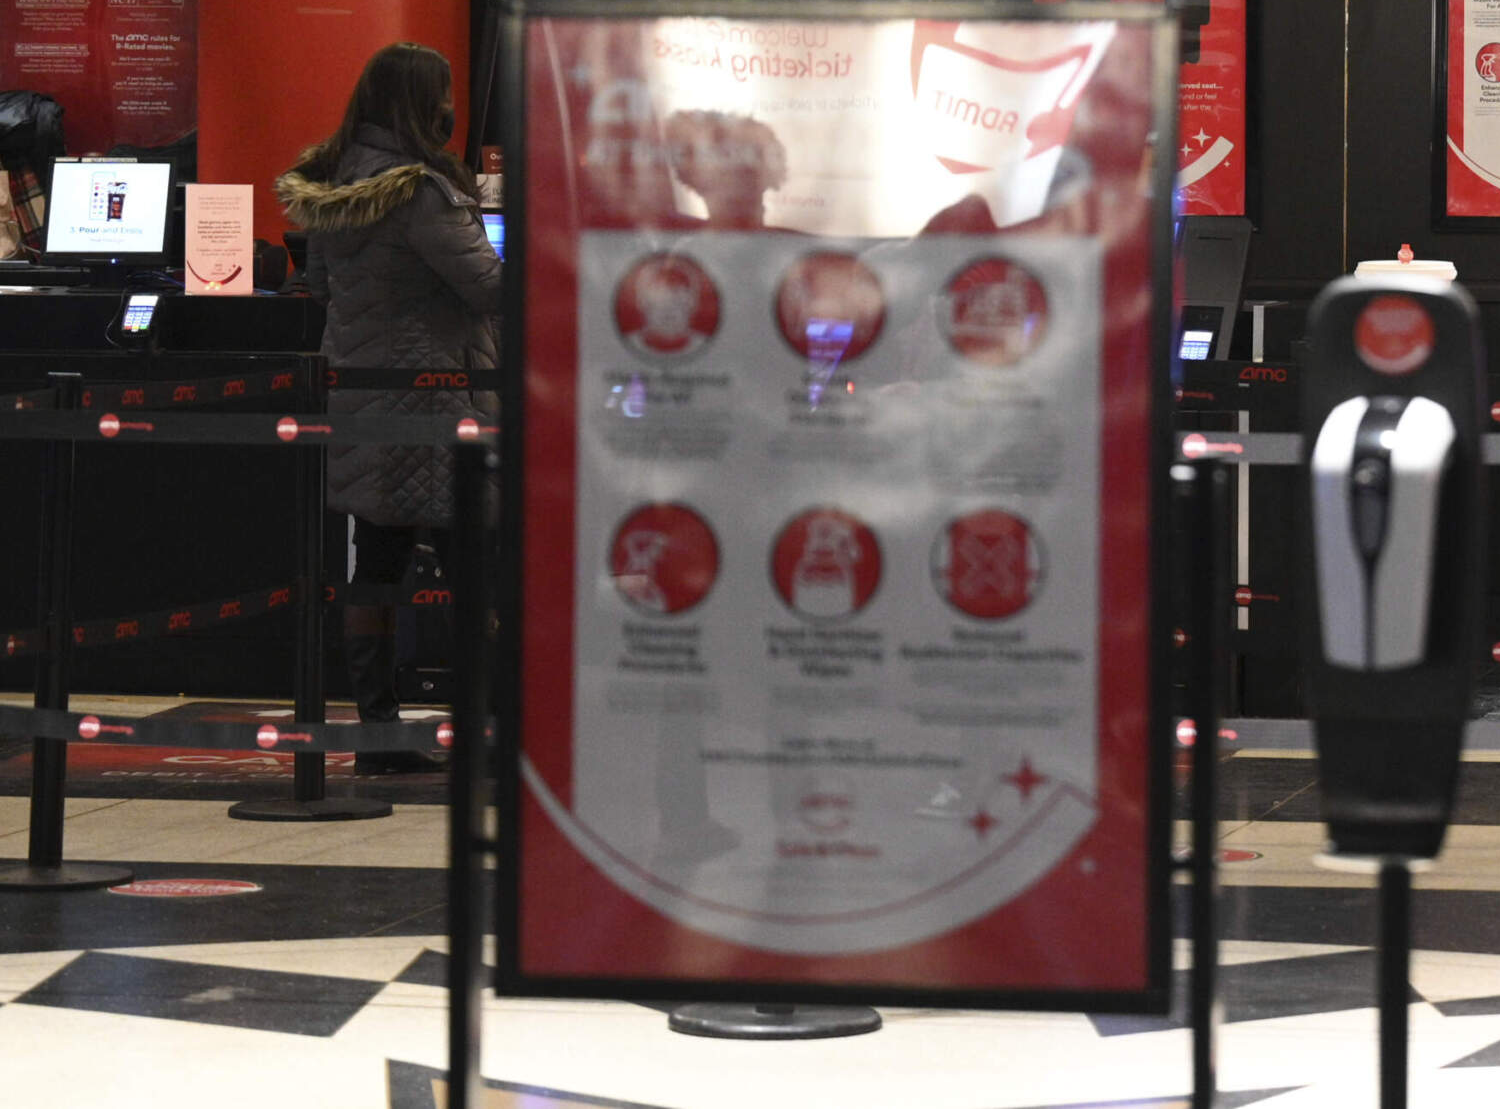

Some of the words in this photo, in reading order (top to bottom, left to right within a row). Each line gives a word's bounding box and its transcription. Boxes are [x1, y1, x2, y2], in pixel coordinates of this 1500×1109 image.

[111, 34, 124, 42] The
[126, 33, 148, 41] amc
[79, 226, 99, 234] Pour
[414, 373, 470, 387] amc
[1239, 367, 1287, 382] amc
